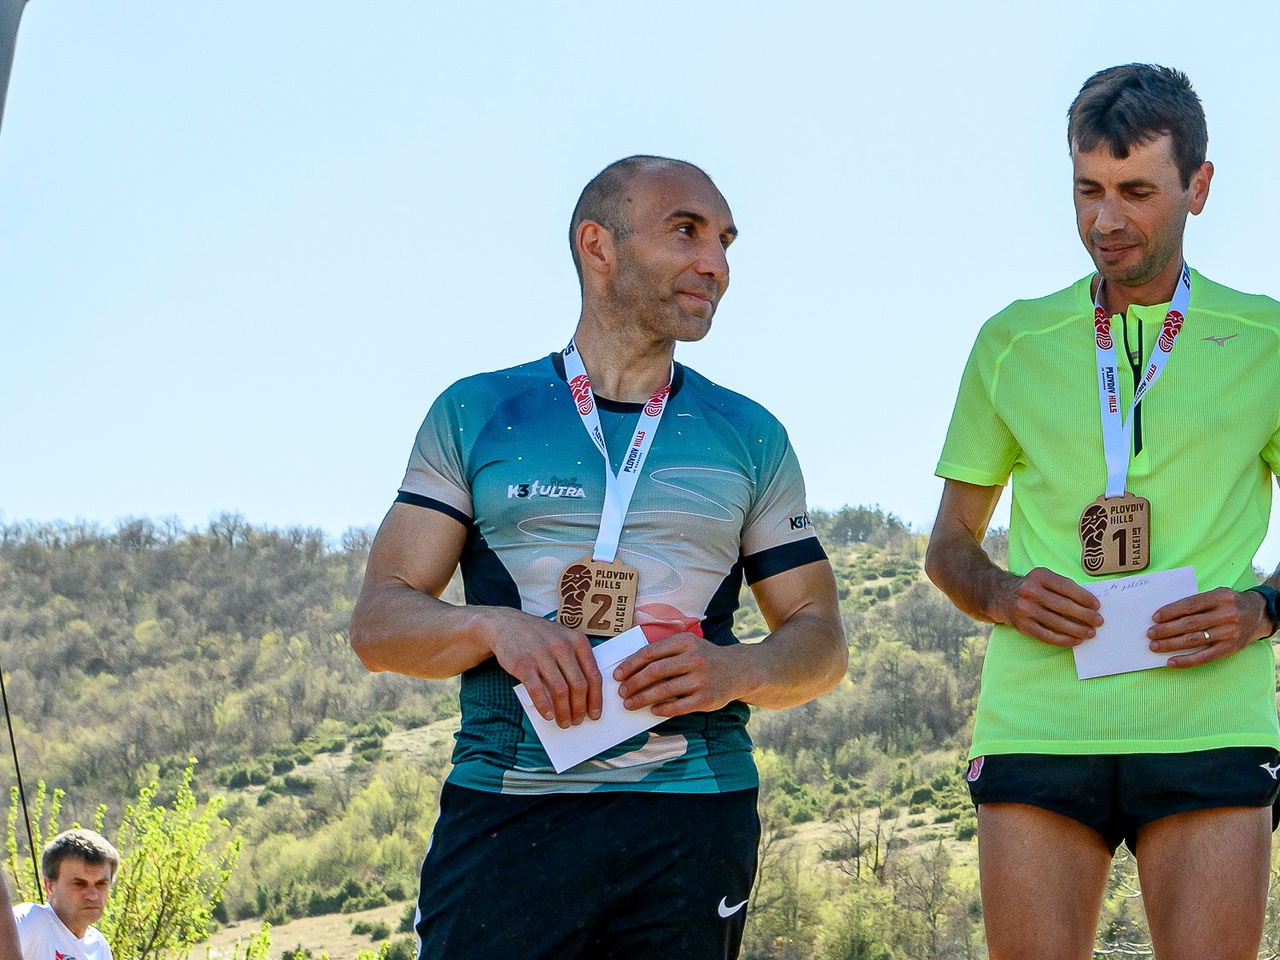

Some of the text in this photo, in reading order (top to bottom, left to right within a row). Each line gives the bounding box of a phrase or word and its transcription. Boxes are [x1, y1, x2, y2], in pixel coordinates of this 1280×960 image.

[1109, 395, 1117, 413] HILLS
[1110, 503, 1144, 515] PLOVDIV
[1110, 514, 1134, 525] HILLS
[1113, 529, 1126, 567] 1
[596, 569, 634, 581] PLOVDIV
[594, 580, 621, 590] HILLS
[587, 593, 613, 630] 2
